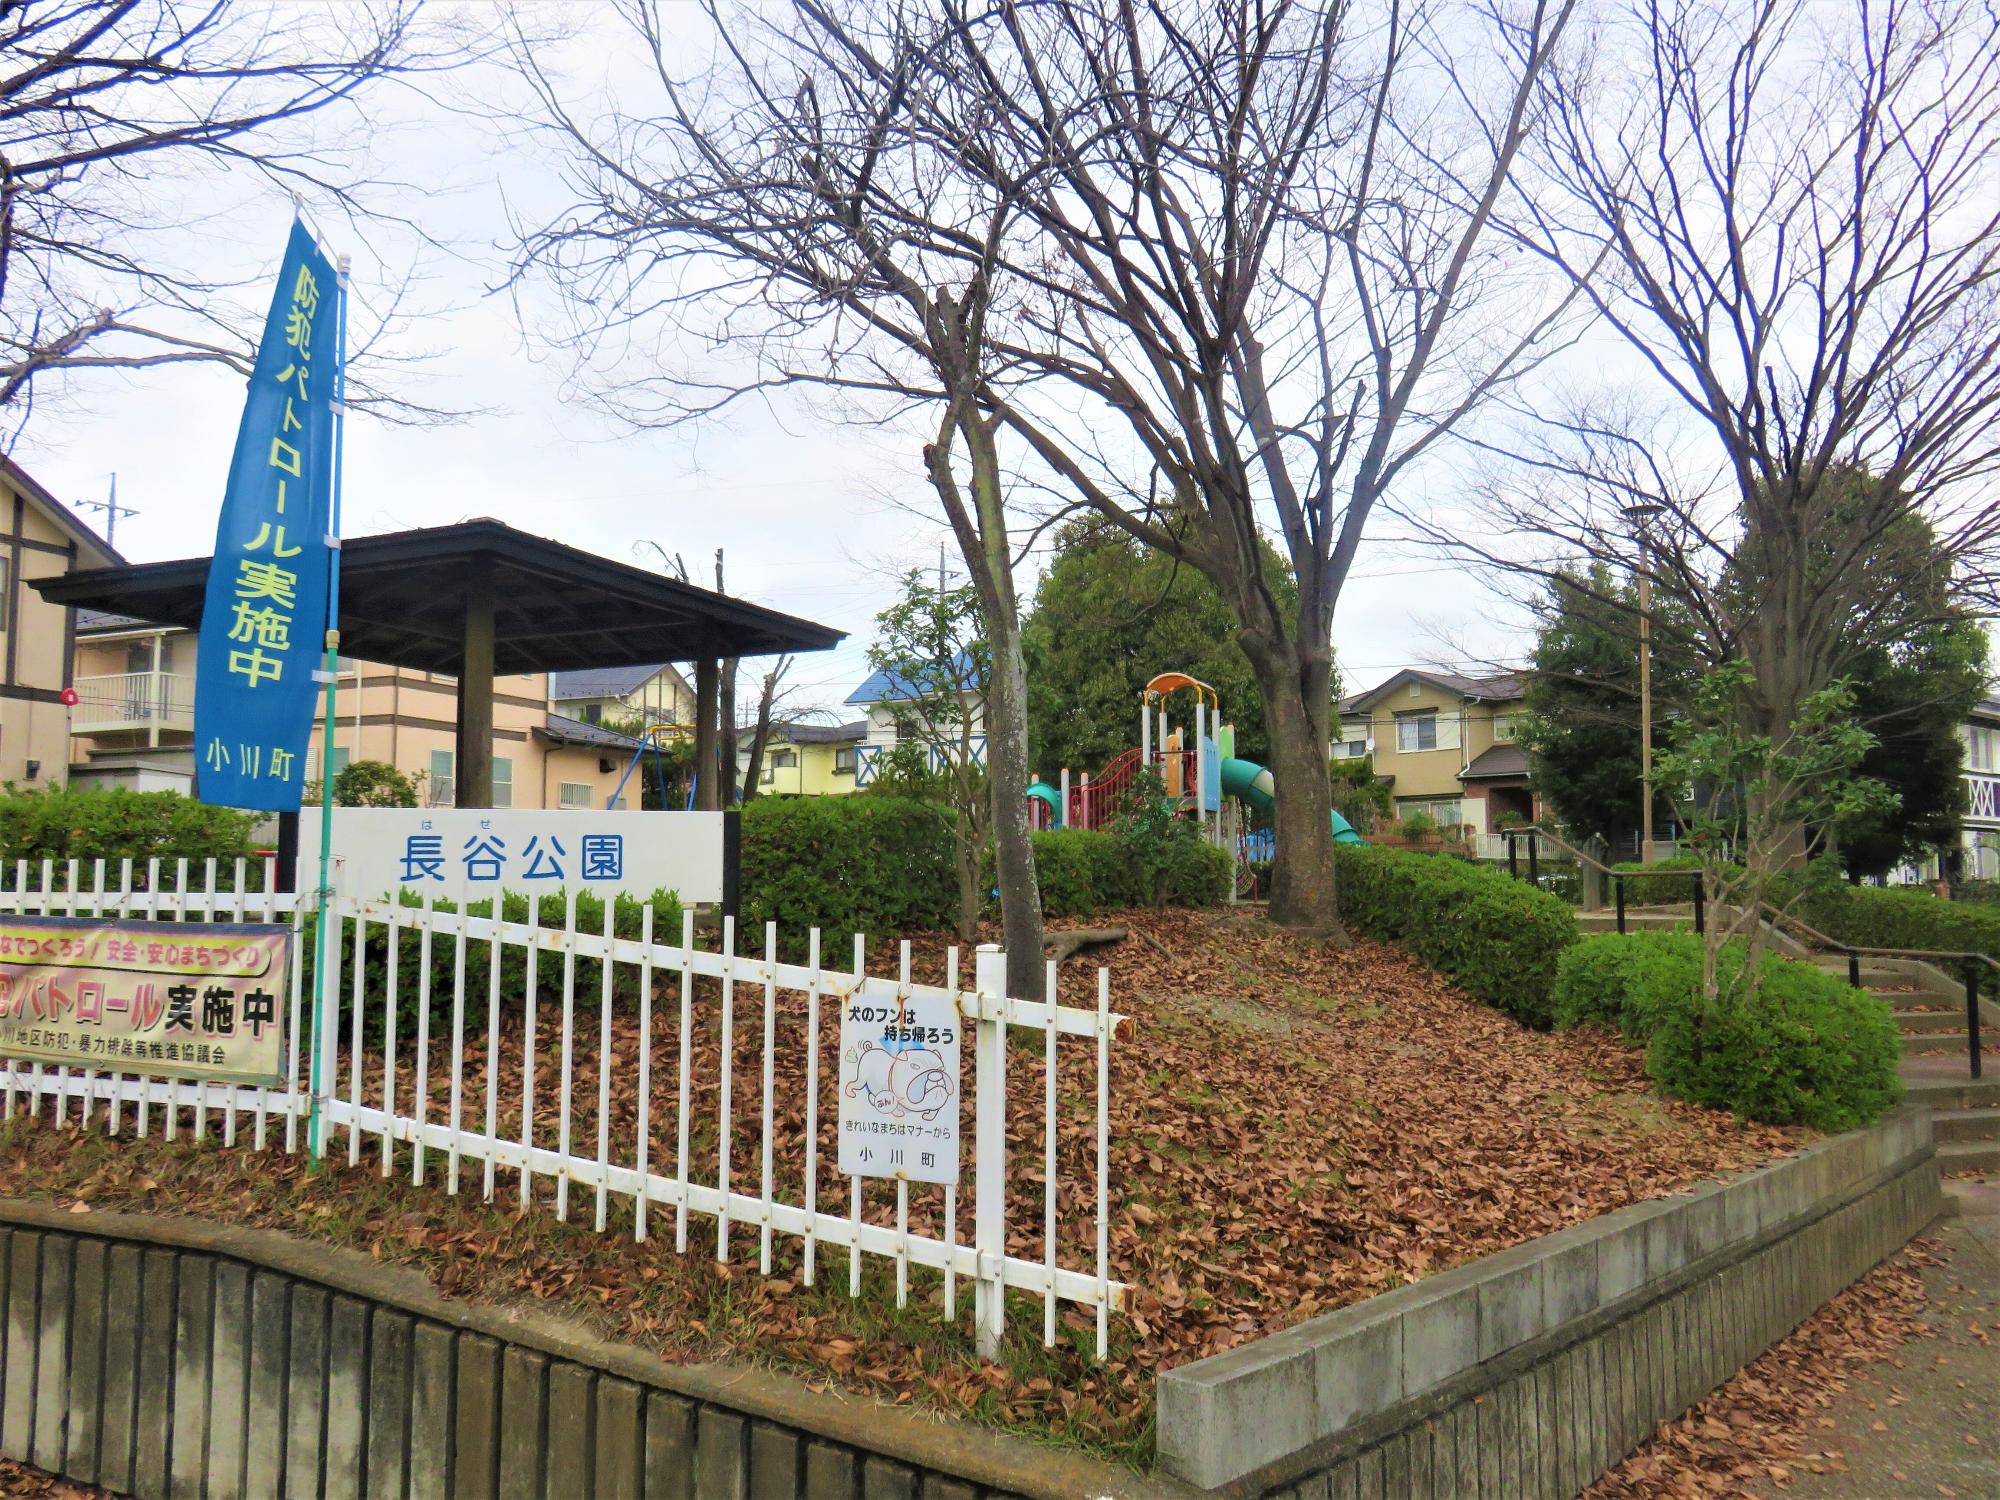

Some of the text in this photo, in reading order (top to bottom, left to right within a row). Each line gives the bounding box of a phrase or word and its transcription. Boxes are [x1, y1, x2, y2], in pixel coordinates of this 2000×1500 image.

[227, 263, 319, 688] 防犯パトロール実施中
[206, 737, 295, 782] 小川町
[400, 834, 623, 881] 長谷公園
[848, 1006, 916, 1024] 犬のフンは
[0, 1025, 226, 1065] 川地区防犯・暴力排除等推進協議会
[884, 1025, 954, 1044] 持ち帰ろう
[845, 1119, 951, 1140] きれいなまちはマナーから
[859, 1146, 935, 1168] 小川町
